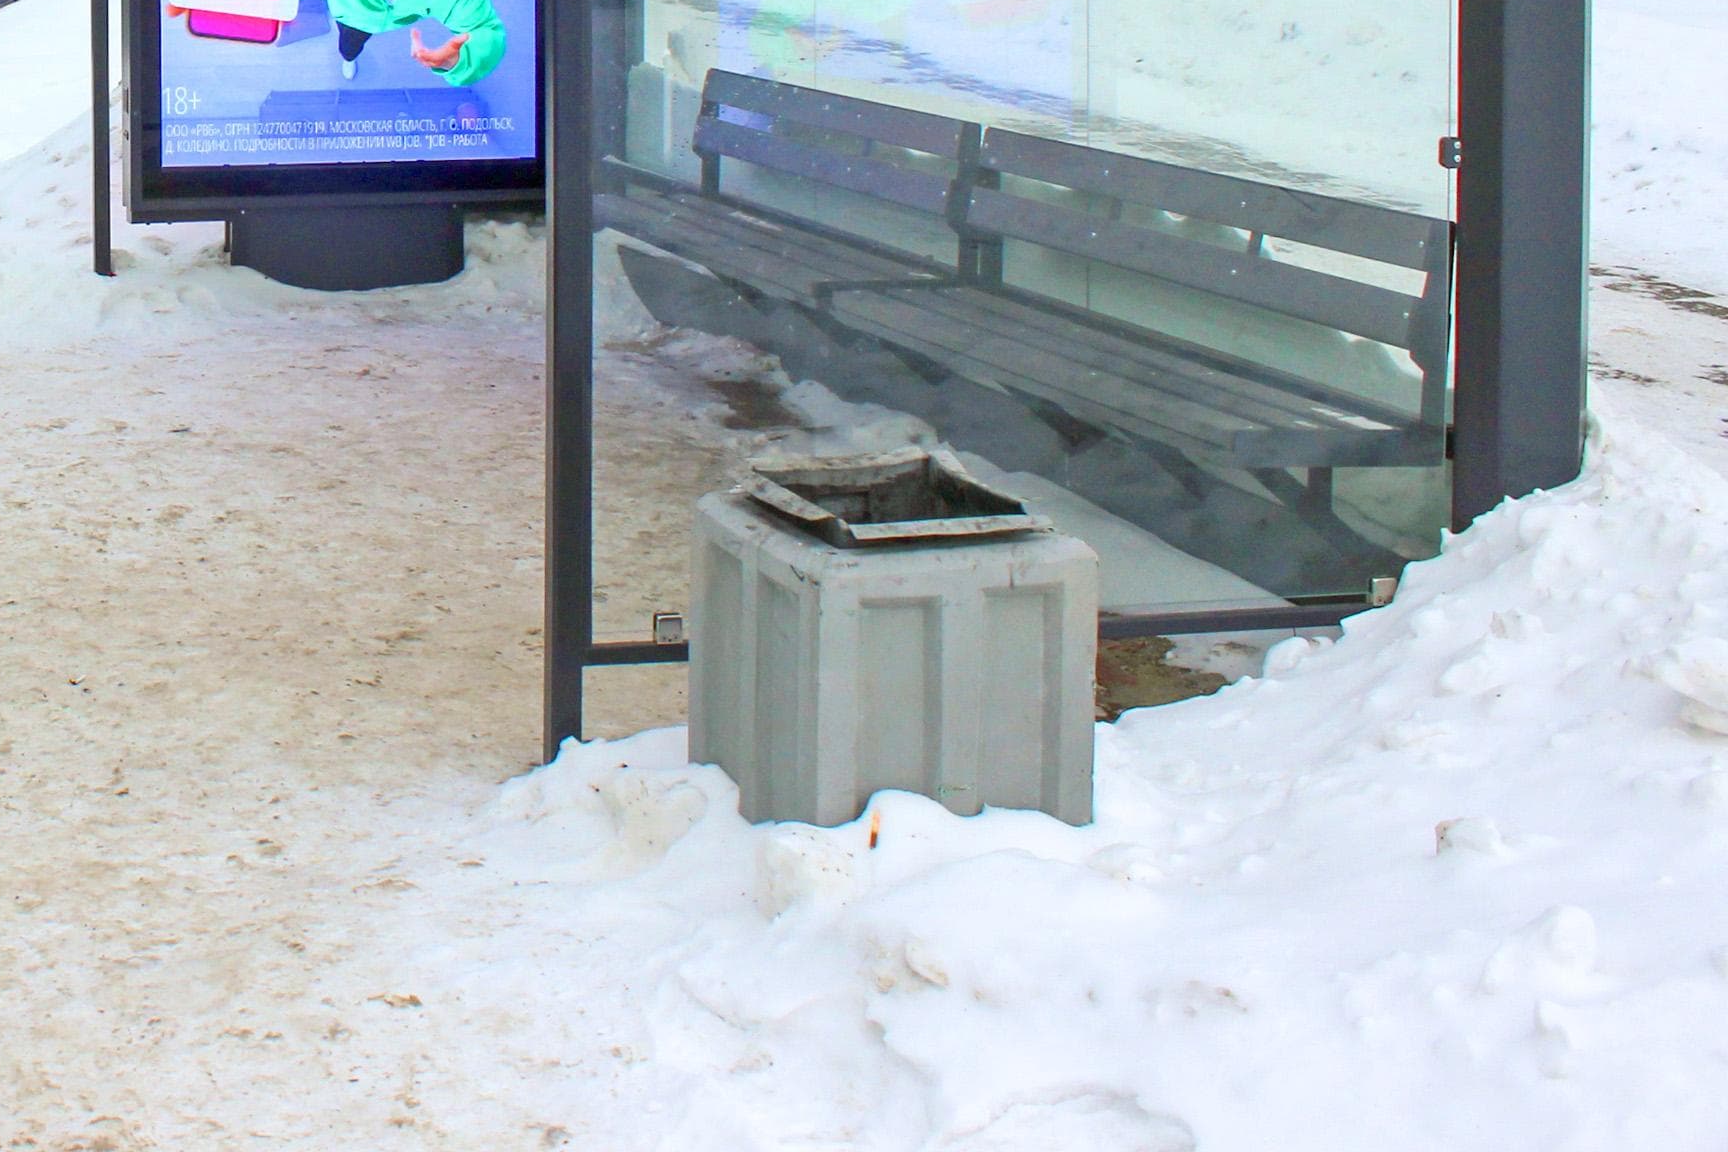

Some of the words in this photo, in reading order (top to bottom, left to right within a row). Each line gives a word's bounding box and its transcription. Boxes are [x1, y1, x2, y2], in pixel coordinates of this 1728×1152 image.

[163, 86, 202, 115] 18+
[165, 124, 189, 137] ООО
[225, 123, 250, 136] ОГРН
[330, 119, 393, 134] МОСКОВСКАЯ
[234, 137, 306, 152] ПОДРОБНОСТИ
[453, 133, 488, 147] РАБОТА
